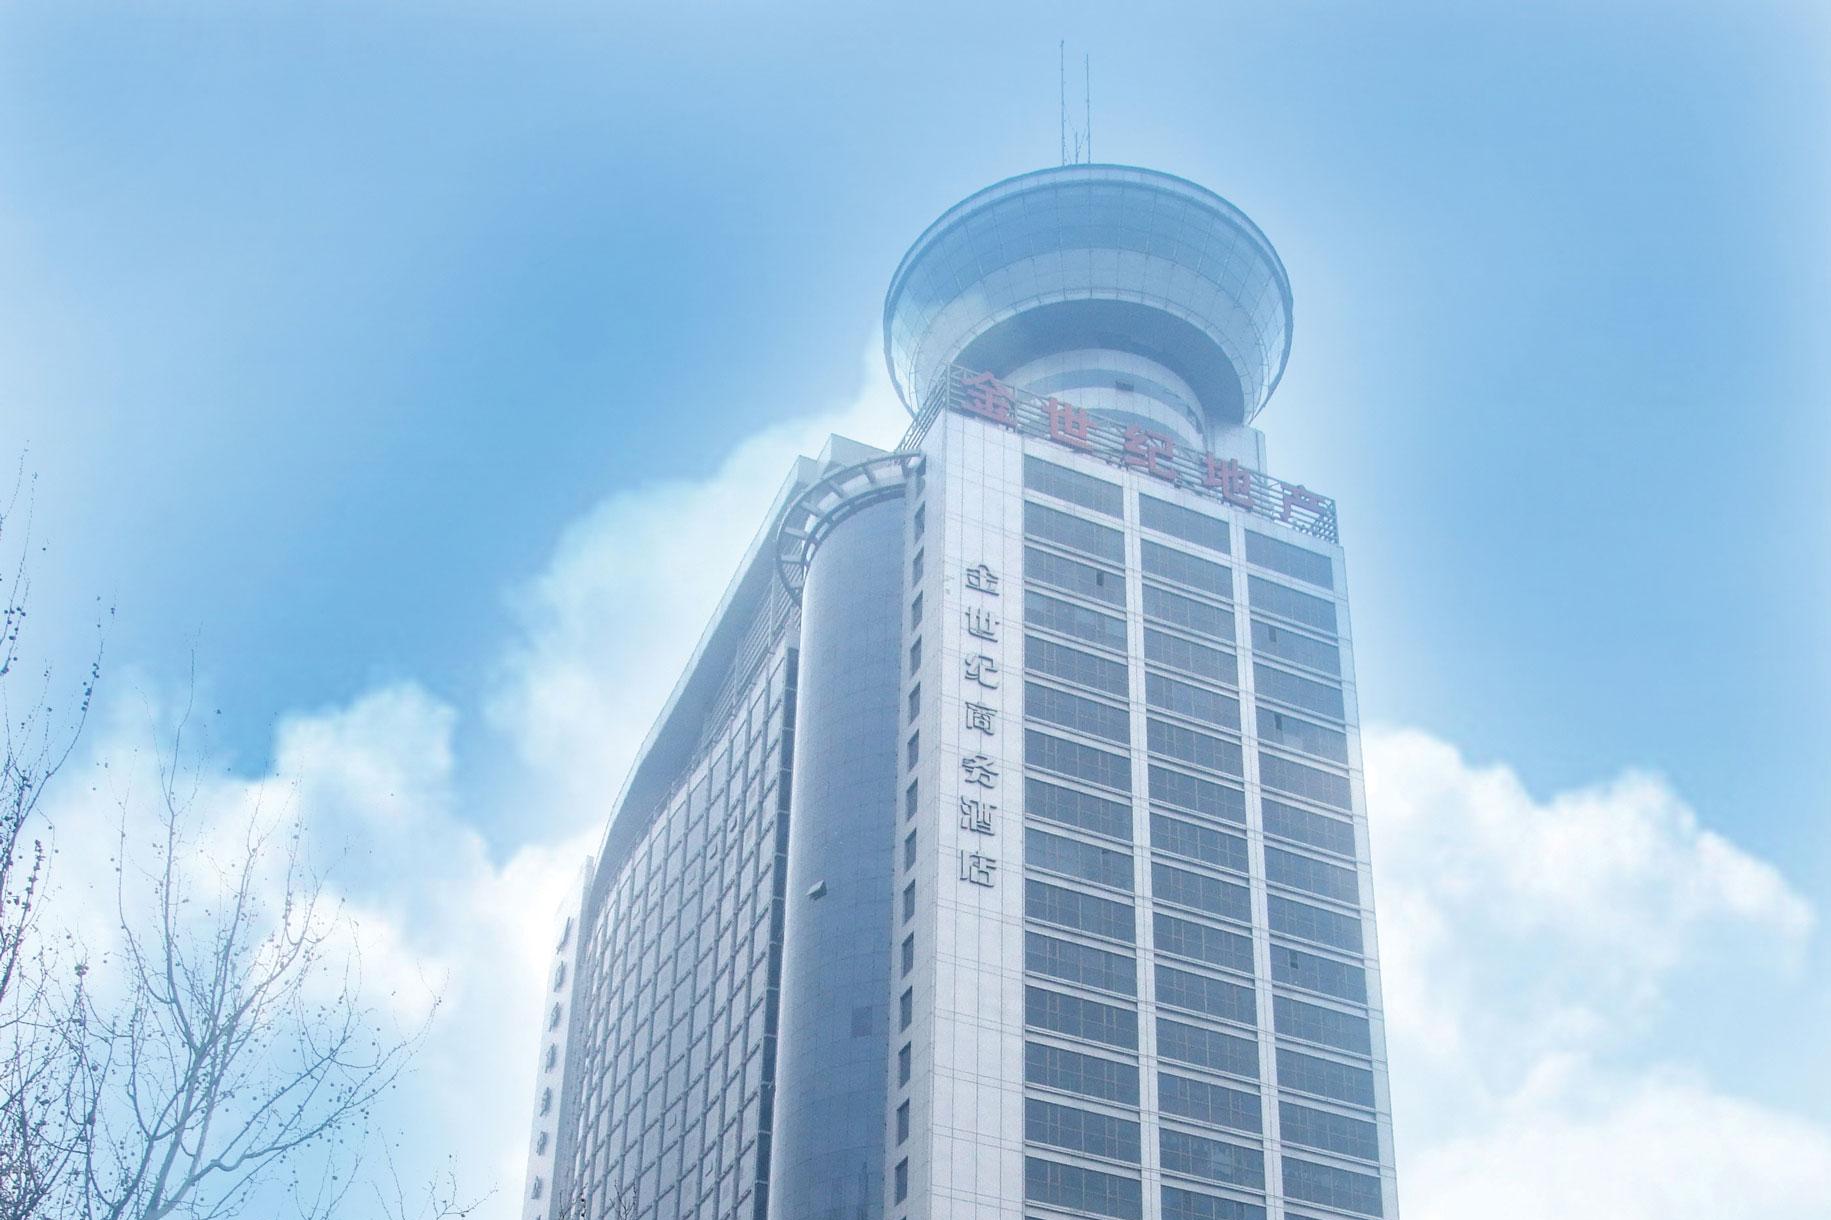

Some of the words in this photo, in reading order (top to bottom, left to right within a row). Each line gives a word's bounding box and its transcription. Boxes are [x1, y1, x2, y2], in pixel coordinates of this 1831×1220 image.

[958, 370, 1324, 522] 金世纪地产
[960, 563, 1000, 889] 金世纪商务酒店
